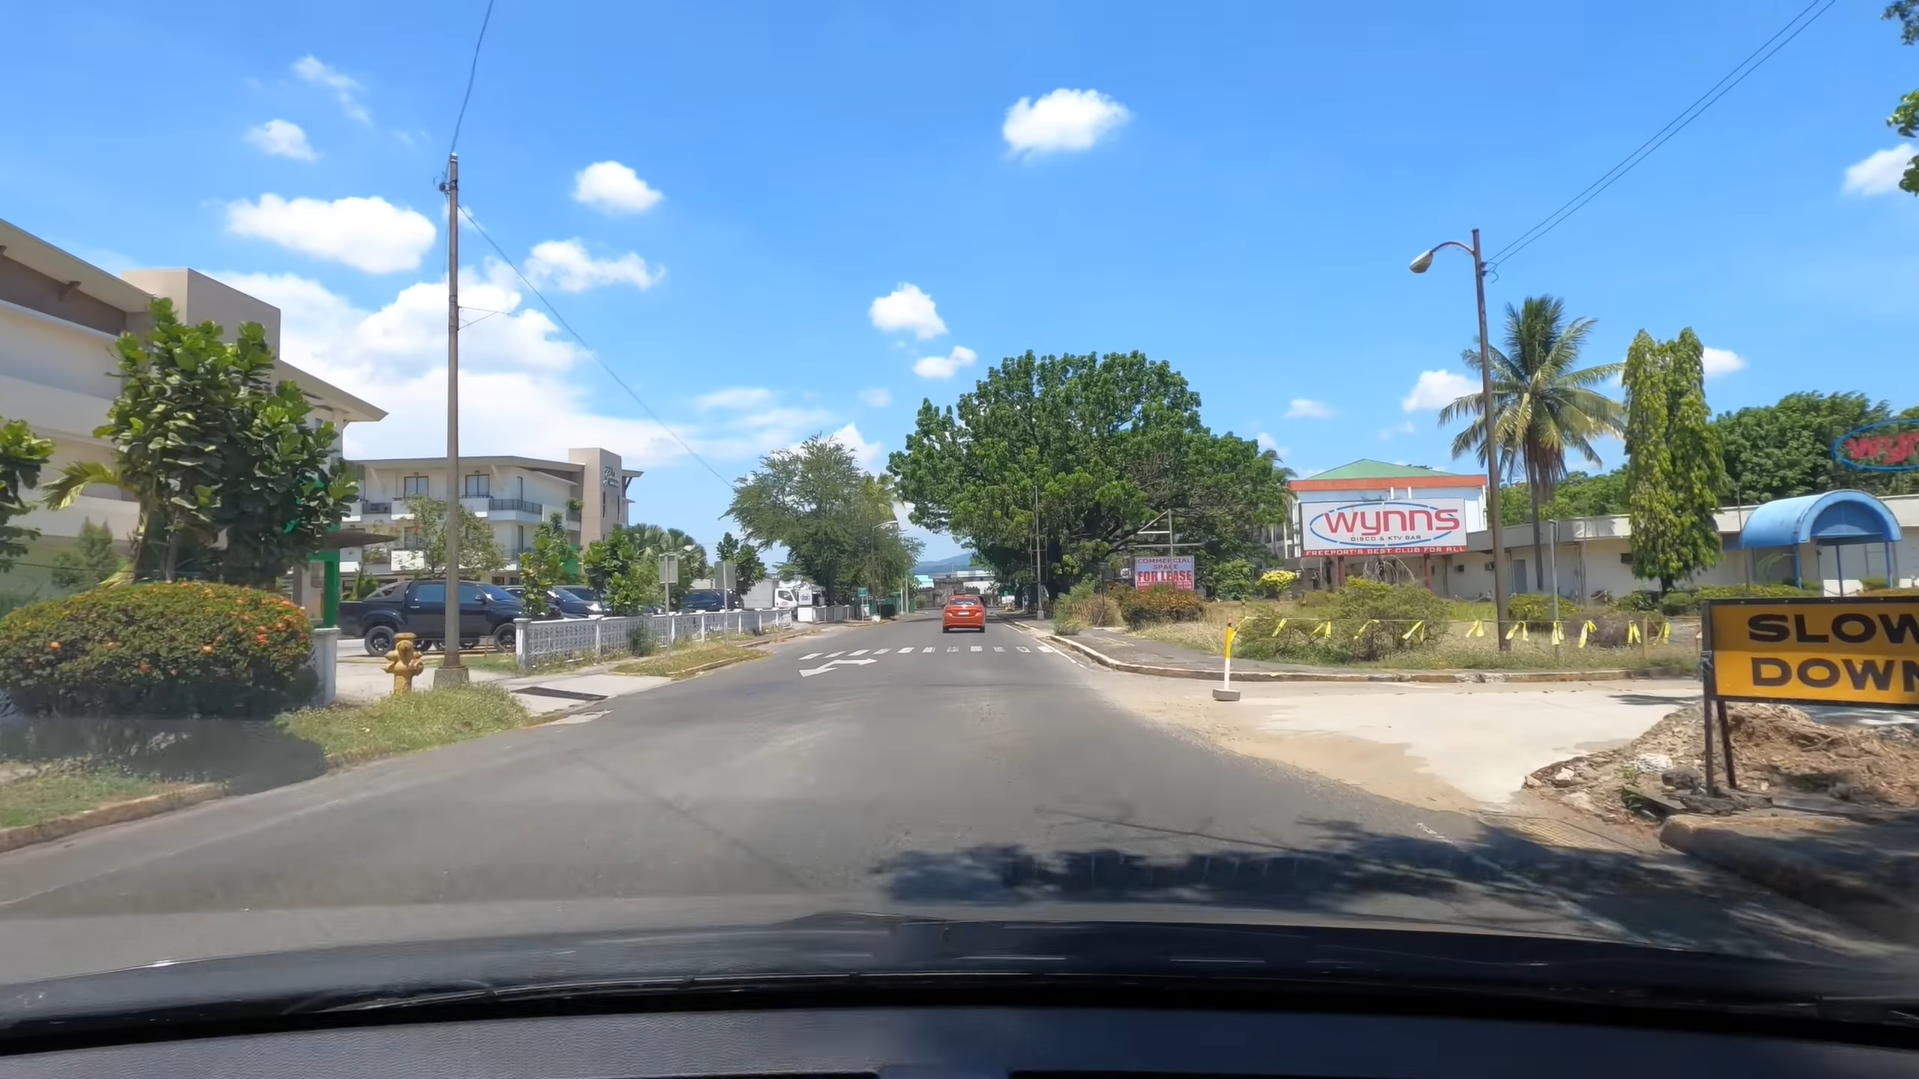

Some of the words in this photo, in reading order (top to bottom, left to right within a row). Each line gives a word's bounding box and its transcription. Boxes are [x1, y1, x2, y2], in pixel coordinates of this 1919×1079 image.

[1137, 571, 1158, 582] FOR
[1161, 571, 1192, 582] LEASE
[1747, 613, 1919, 644] SLOW
